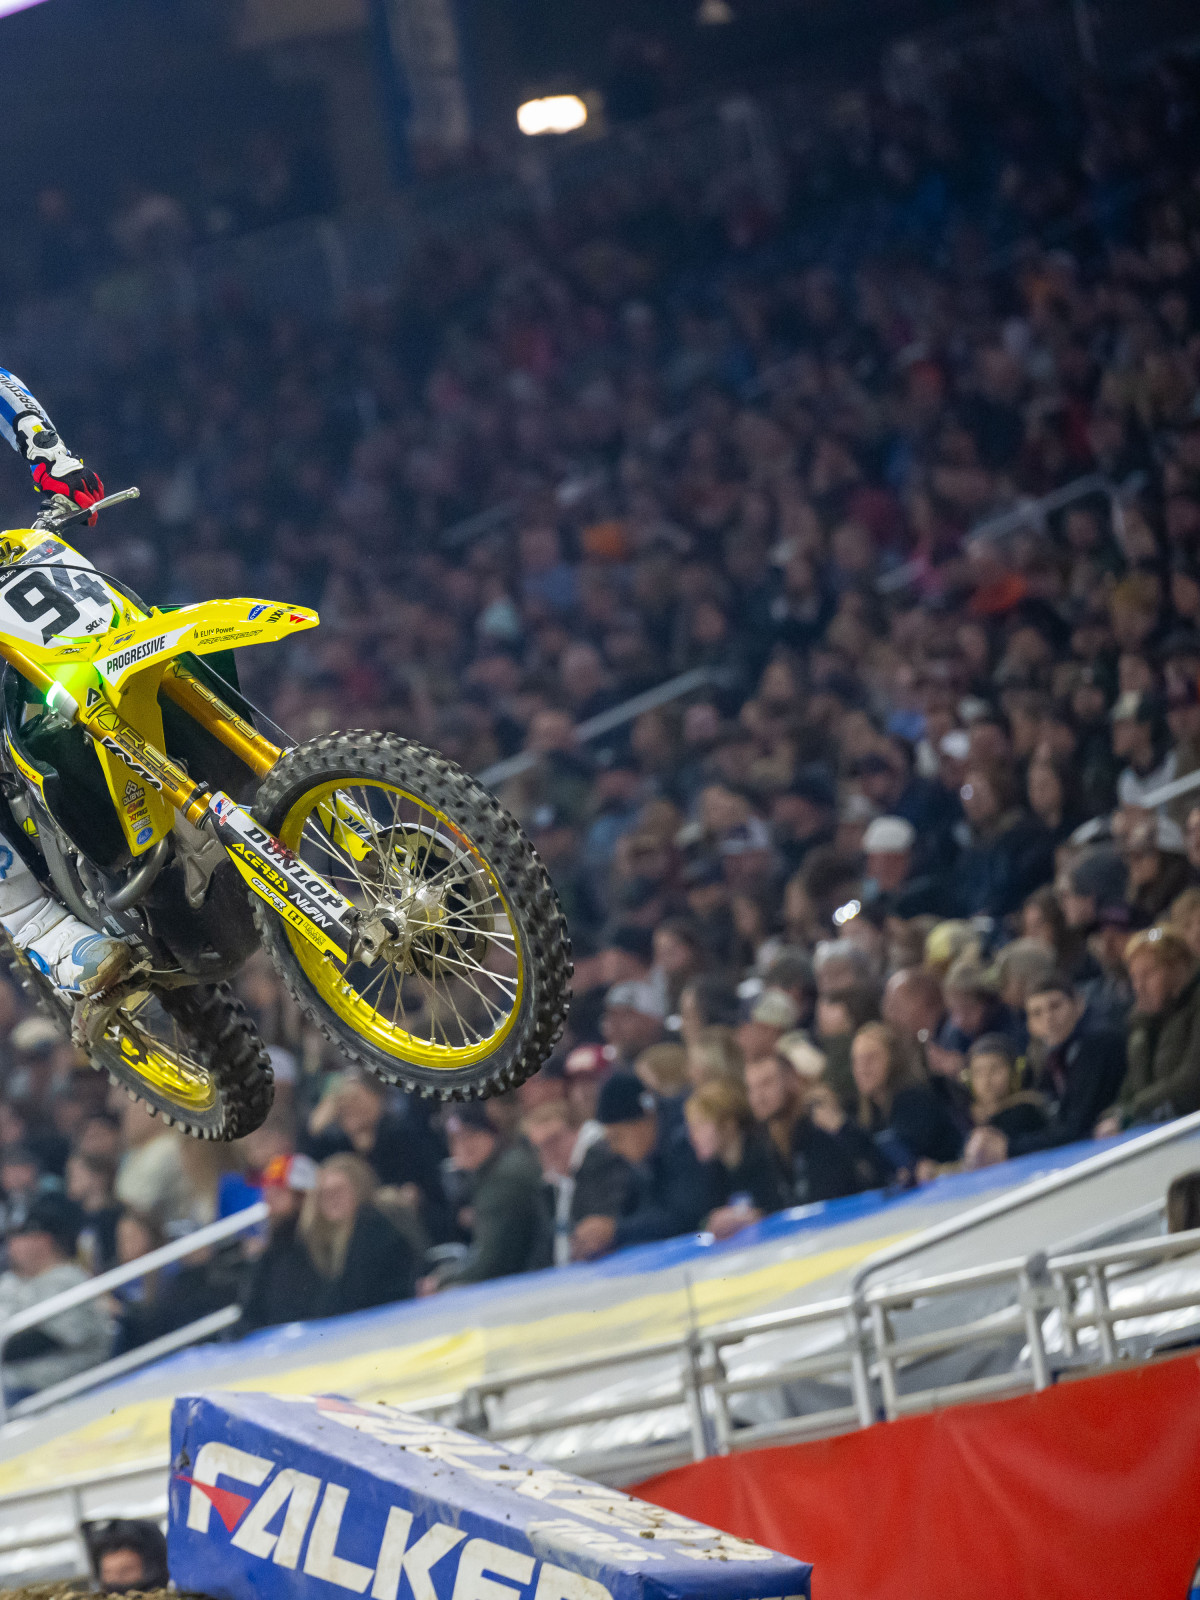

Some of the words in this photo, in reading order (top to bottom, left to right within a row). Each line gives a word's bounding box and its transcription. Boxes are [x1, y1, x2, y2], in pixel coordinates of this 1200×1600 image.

[4, 558, 110, 646] 94
[215, 621, 234, 635] Power
[106, 634, 166, 675] PROGRESSIVE
[232, 843, 289, 892] ACERBIS
[244, 827, 343, 909] DUNLOP
[180, 1441, 616, 1600] FALKE
